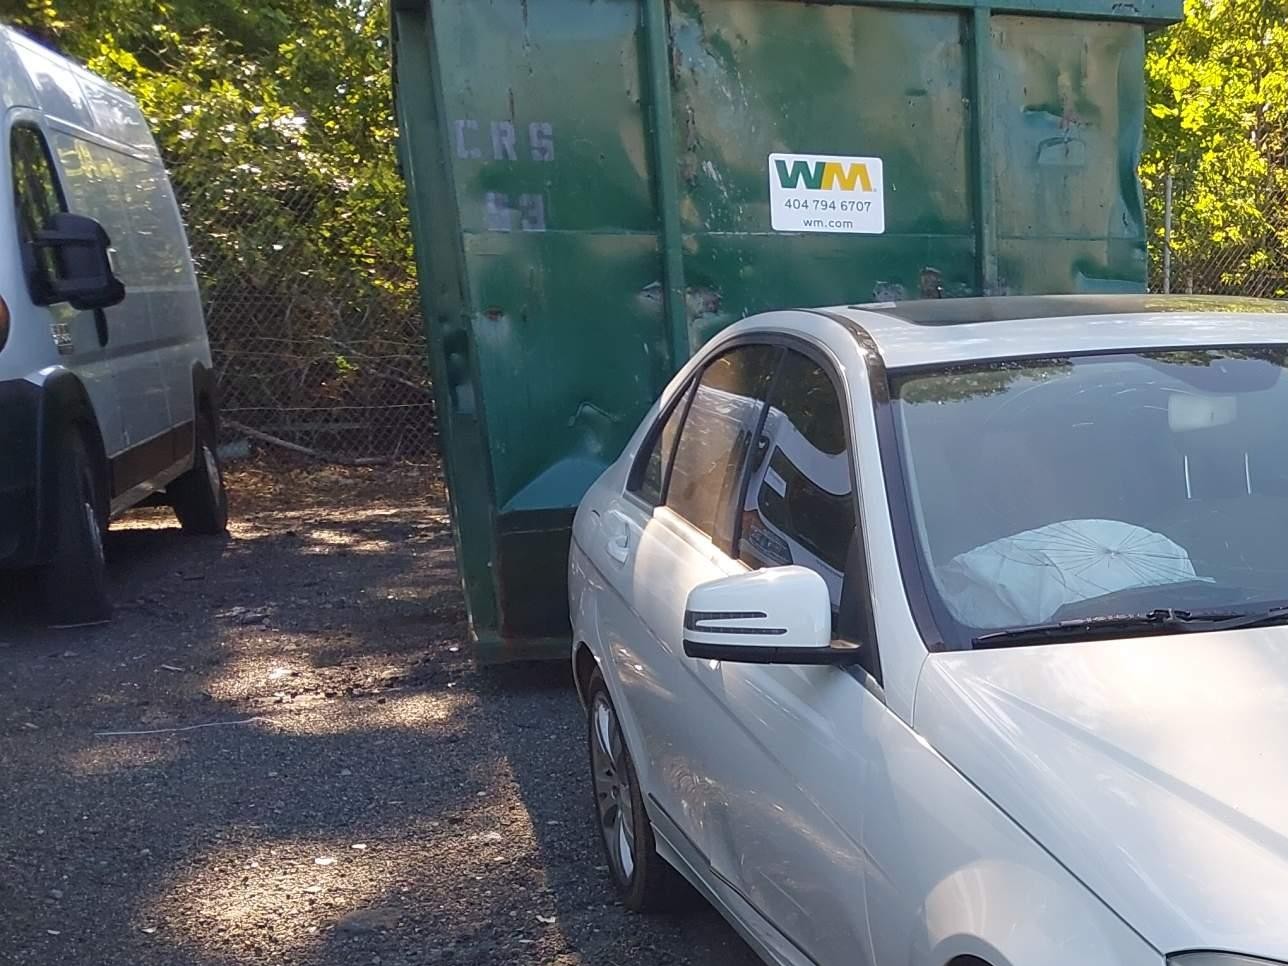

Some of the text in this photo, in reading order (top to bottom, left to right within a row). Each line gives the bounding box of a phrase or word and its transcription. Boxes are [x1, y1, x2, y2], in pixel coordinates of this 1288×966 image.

[775, 160, 872, 192] WM
[784, 199, 872, 212] 404 794 6707
[803, 219, 853, 229] wm.com
